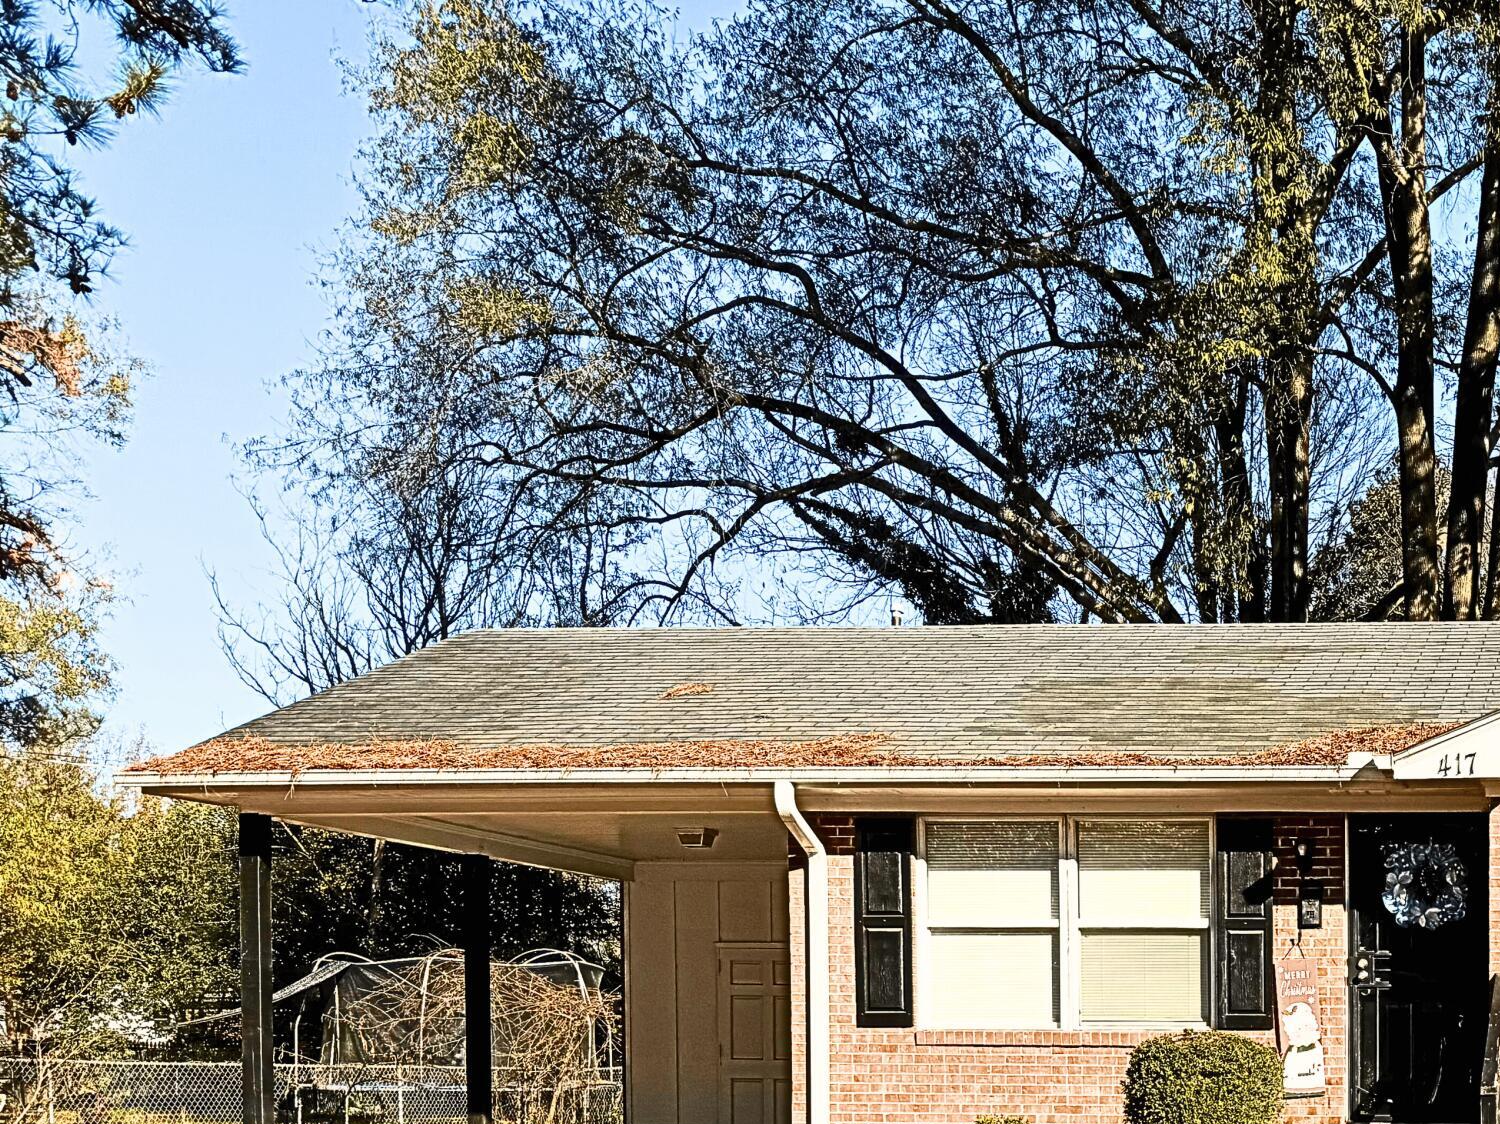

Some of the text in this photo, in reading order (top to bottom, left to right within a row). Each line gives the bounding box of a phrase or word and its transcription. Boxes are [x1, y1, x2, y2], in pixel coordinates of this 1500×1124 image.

[1437, 752, 1477, 777] 417
[1284, 970, 1311, 980] MERRY
[1280, 980, 1316, 998] Christmas
